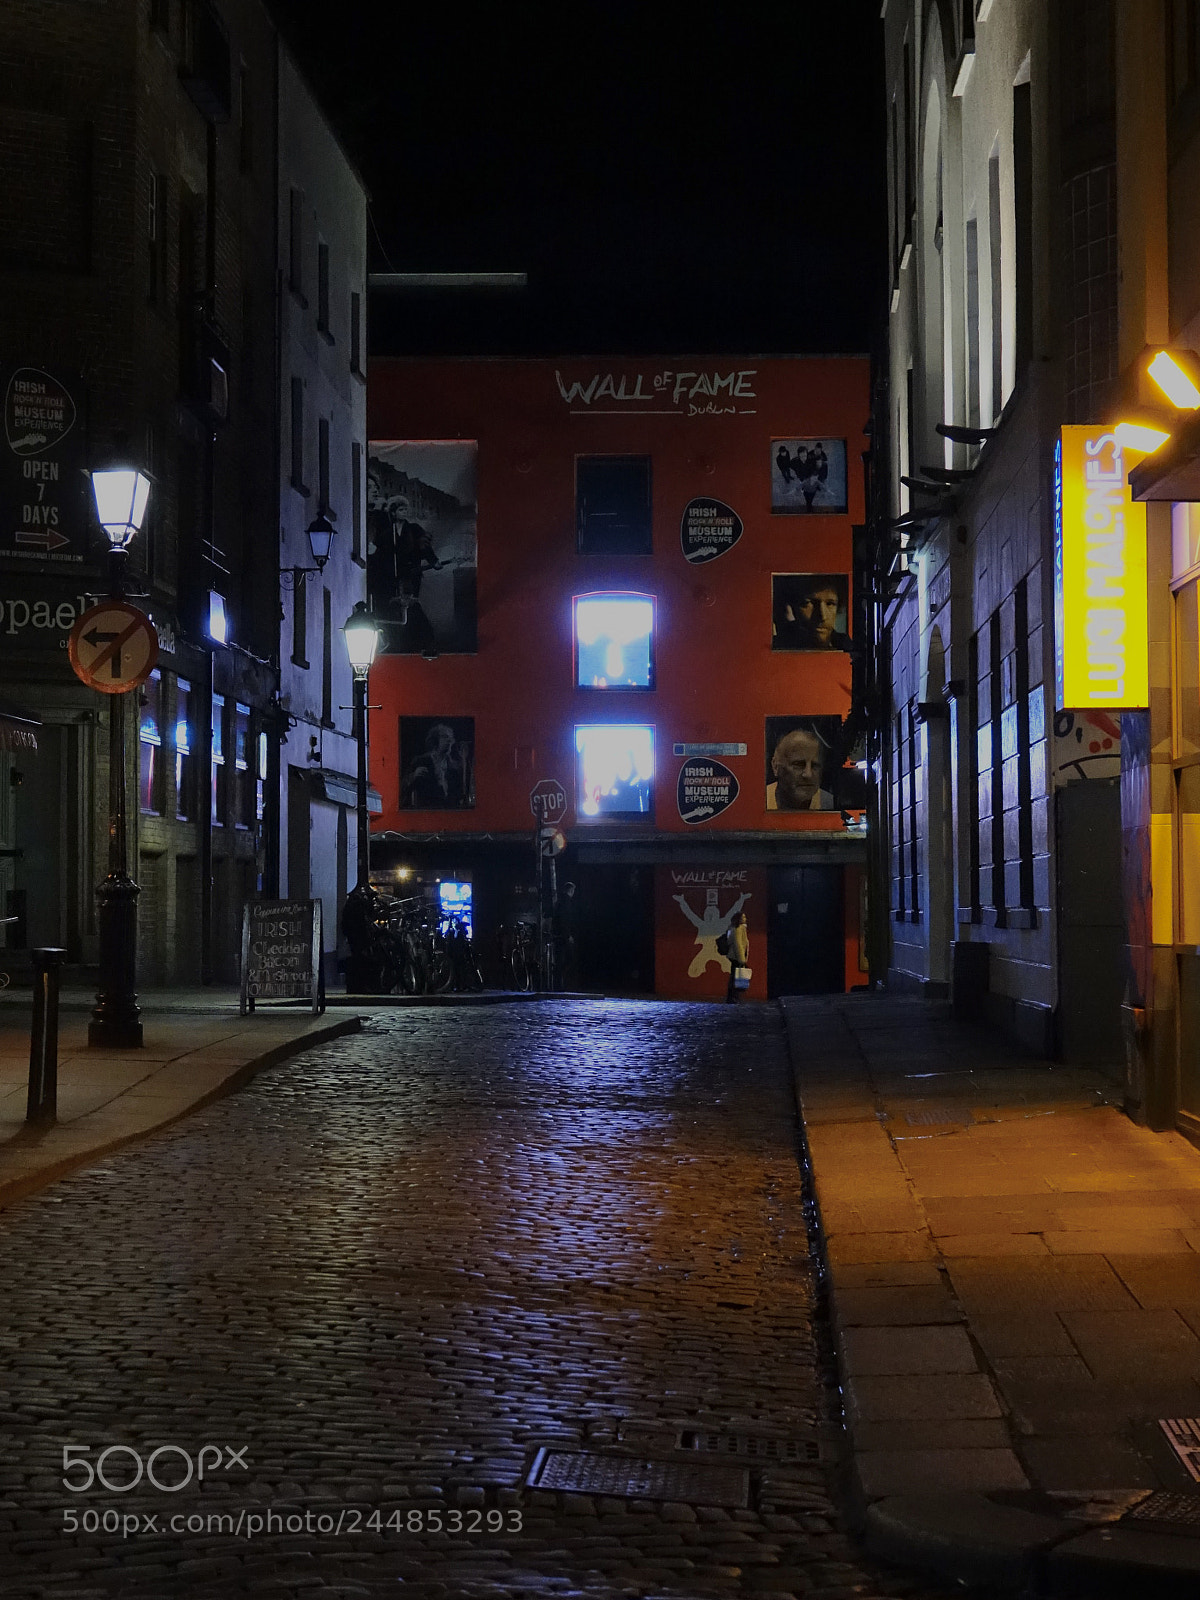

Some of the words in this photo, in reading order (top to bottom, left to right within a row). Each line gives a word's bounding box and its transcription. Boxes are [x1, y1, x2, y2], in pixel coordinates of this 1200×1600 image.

[14, 380, 46, 394] IRISH
[555, 370, 654, 404] WALL
[653, 371, 673, 390] OF
[672, 370, 757, 404] FAME
[14, 405, 64, 421] MUSEUM
[23, 460, 59, 480] OPEN
[37, 483, 46, 501] 7
[22, 504, 59, 525] DAYS
[689, 507, 717, 517] IRISH
[688, 526, 733, 536] MUSEUM
[688, 535, 733, 544] EXPERIENCE
[685, 767, 714, 777] IRISH
[684, 786, 729, 796] MUSEUM
[533, 792, 564, 811] STOP
[685, 795, 729, 804] EXPERIENCE
[671, 870, 709, 884] WALL
[715, 870, 748, 884] FAME
[257, 921, 303, 938] IRISH
[252, 940, 309, 956] Cheddar
